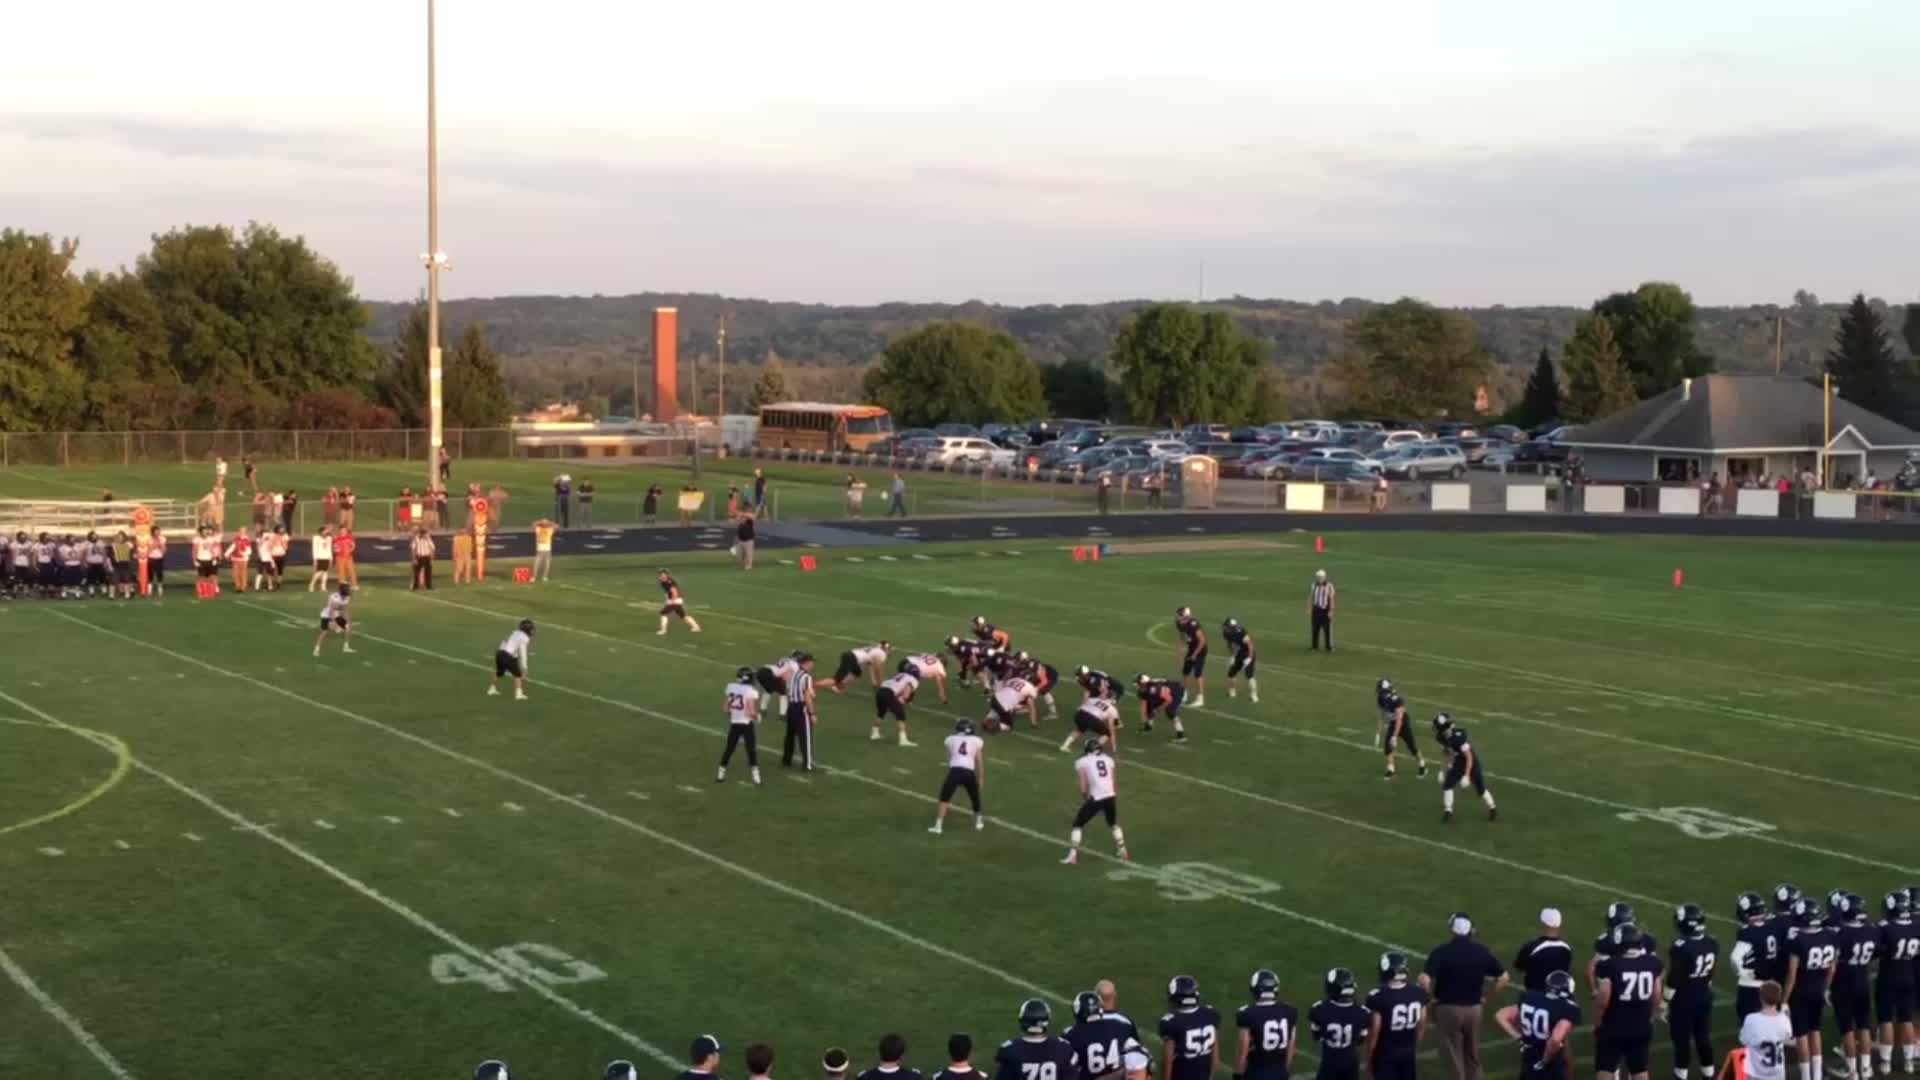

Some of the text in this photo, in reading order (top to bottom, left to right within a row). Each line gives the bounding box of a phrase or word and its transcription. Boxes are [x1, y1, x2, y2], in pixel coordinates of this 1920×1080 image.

[729, 692, 744, 710] 23
[958, 741, 967, 756] 4
[1096, 760, 1107, 777] 9
[1765, 935, 1777, 959] 9
[1807, 945, 1835, 970] 82
[429, 942, 608, 992] 40
[1689, 953, 1715, 978] 12
[1620, 971, 1653, 1001] 70
[1391, 1001, 1421, 1030] 60
[1520, 1003, 1549, 1039] 50
[1185, 1025, 1216, 1058] 52
[1263, 1018, 1288, 1050] 61
[1327, 1023, 1352, 1048] 31
[1087, 1038, 1120, 1073] 64
